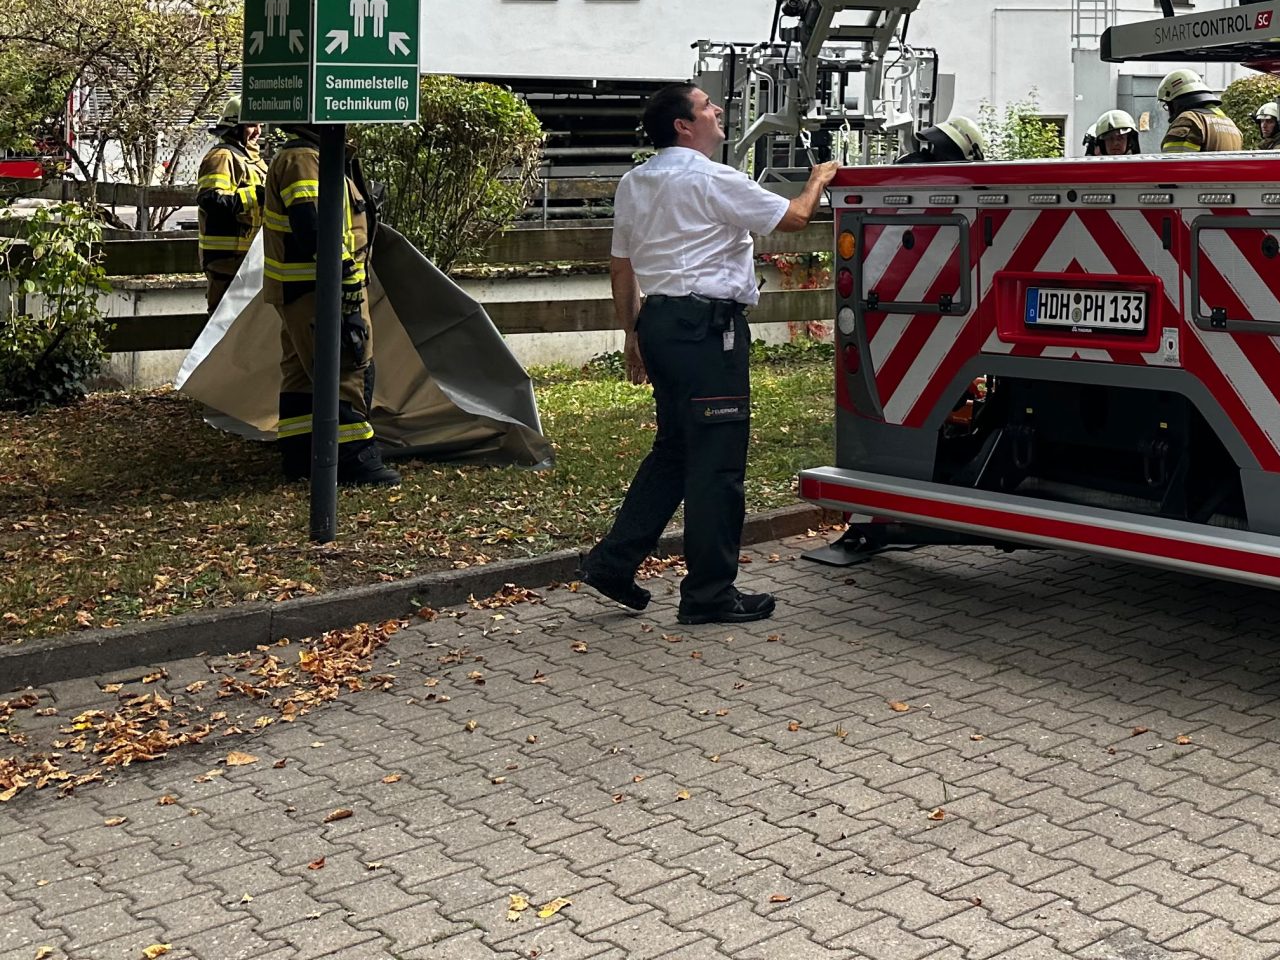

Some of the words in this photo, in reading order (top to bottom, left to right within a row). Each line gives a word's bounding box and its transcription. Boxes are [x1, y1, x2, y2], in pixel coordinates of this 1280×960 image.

[1154, 14, 1252, 45] SMARTCONTROL
[1258, 13, 1270, 26] SC
[249, 75, 303, 90] Sammelstelle
[325, 75, 409, 90] Sammelstelle
[248, 96, 291, 111] Technikum
[293, 96, 303, 111] (6)
[324, 96, 392, 111] Technikum
[394, 96, 409, 111] (6)
[1037, 292, 1071, 321] HDH
[1083, 294, 1105, 322] PH
[1109, 295, 1143, 324] 133
